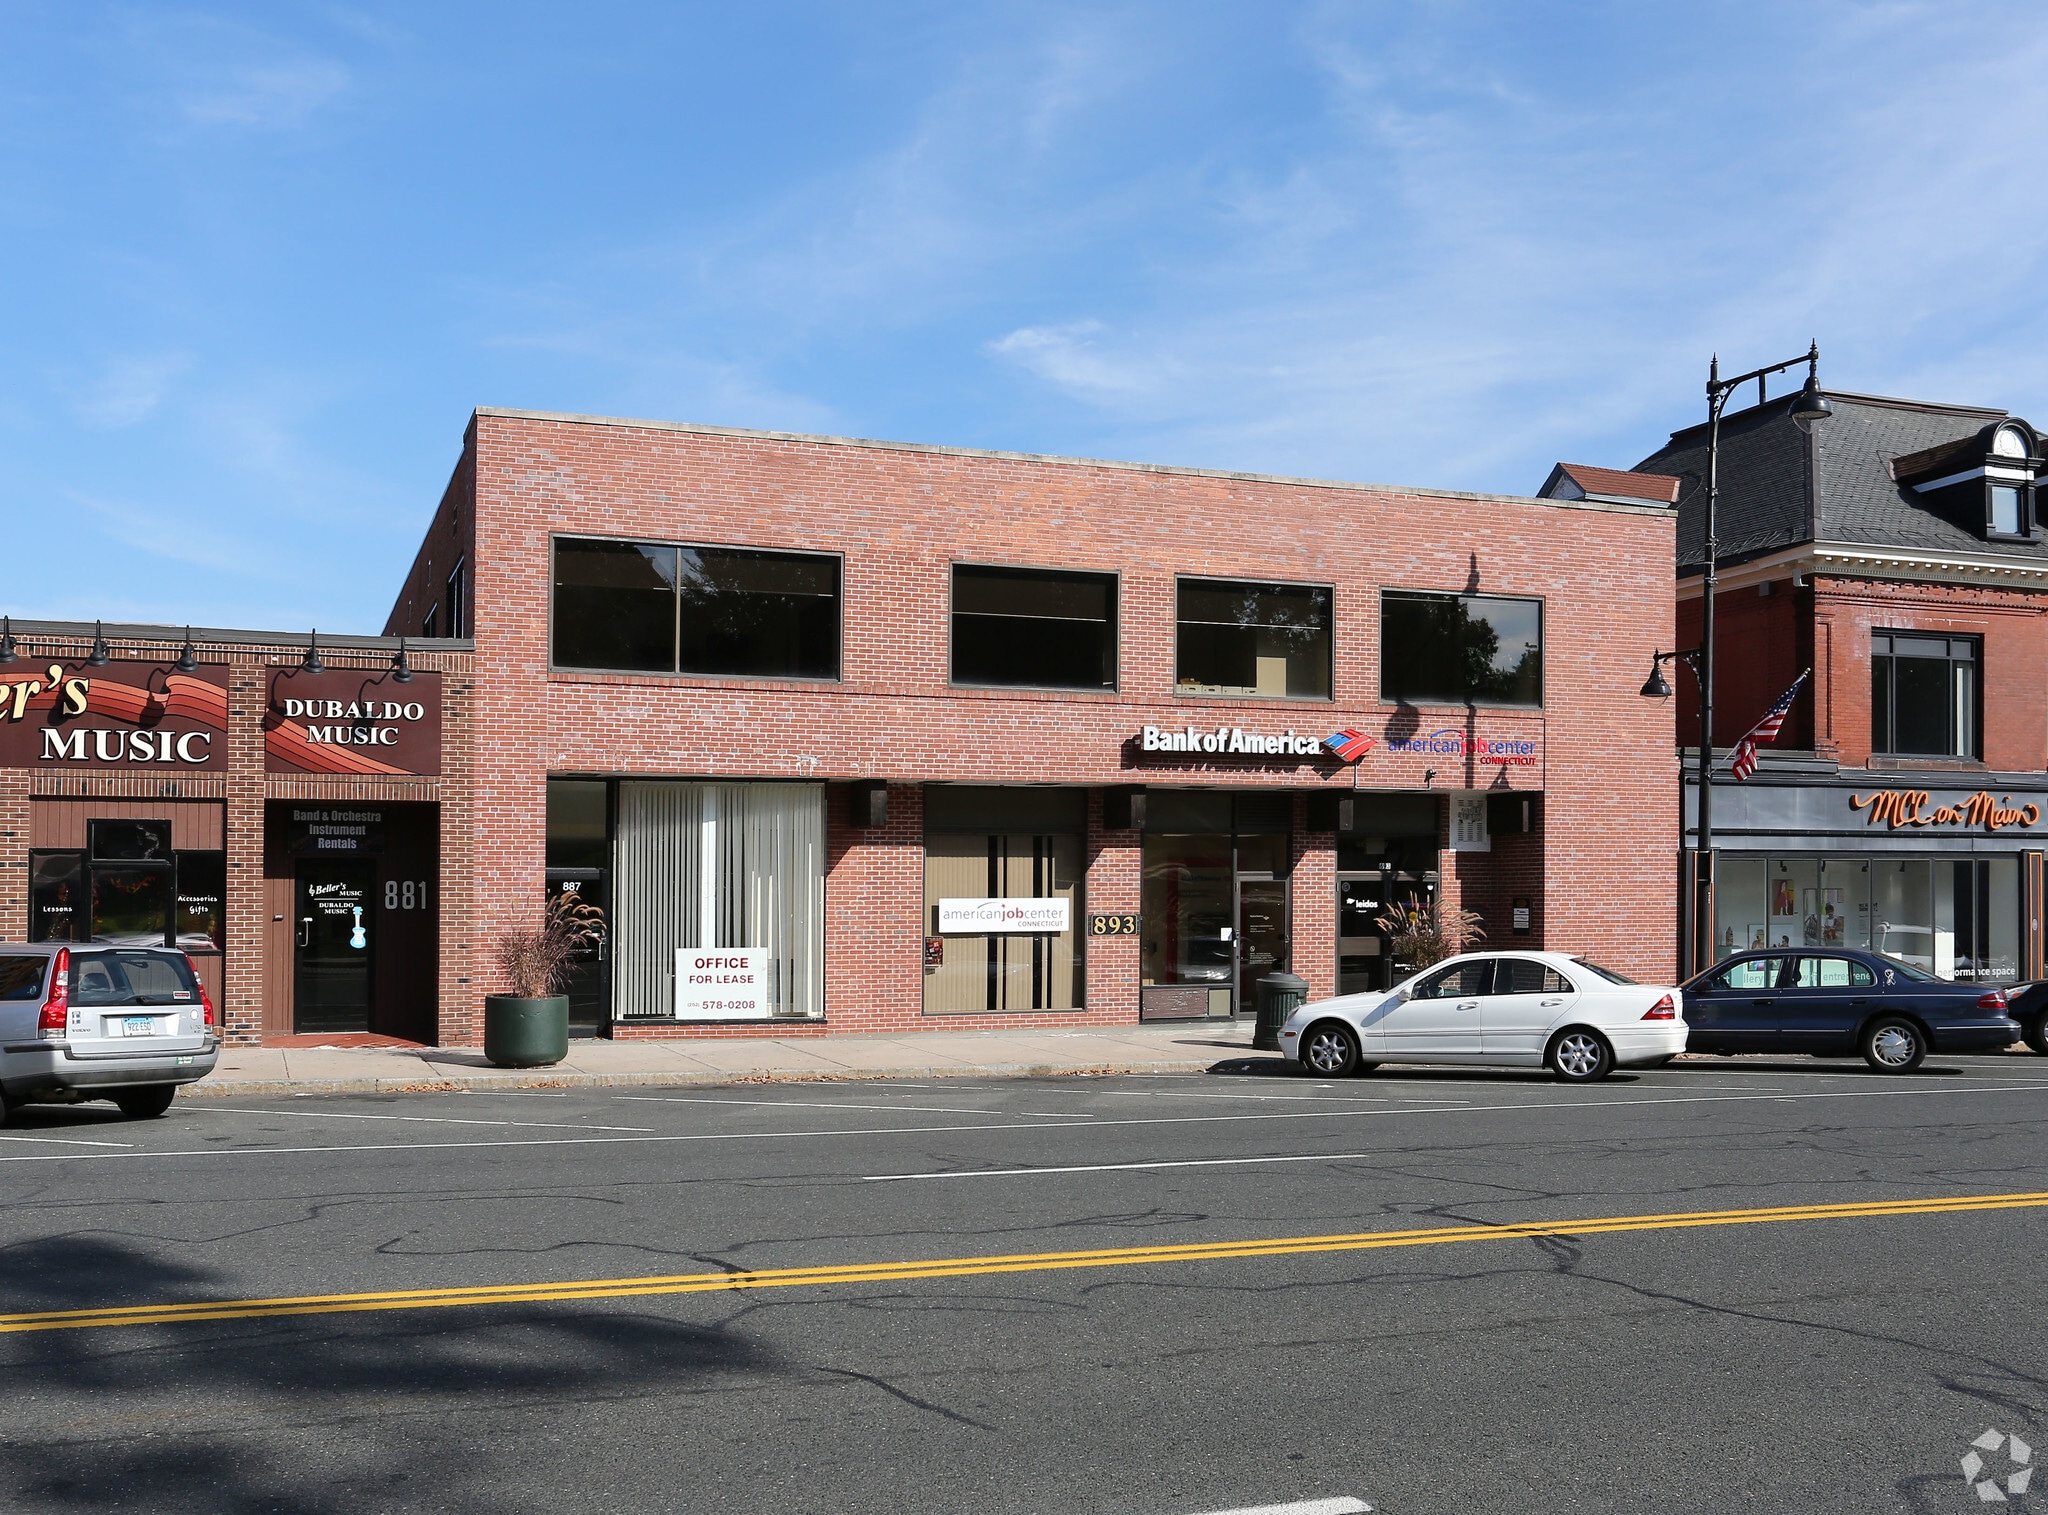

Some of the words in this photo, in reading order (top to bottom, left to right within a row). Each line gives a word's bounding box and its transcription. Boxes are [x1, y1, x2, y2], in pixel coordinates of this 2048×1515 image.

[284, 698, 425, 721] DUBALDO
[306, 725, 399, 745] MUSIC
[1143, 725, 1203, 752] Bank
[1203, 728, 1229, 753] of
[1228, 728, 1320, 756] America
[39, 728, 211, 763] MUSIC
[1480, 756, 1537, 766] CONNECTICUT
[1937, 806, 1965, 823] on
[1957, 790, 2040, 829] Main
[293, 810, 320, 821] Band
[321, 811, 329, 821] &
[331, 811, 381, 822] Orchestra
[309, 824, 366, 835] Instrument
[318, 838, 357, 849] Rentals
[315, 882, 347, 895] Beller's
[562, 881, 582, 891] 887
[177, 895, 218, 903] Accessories
[384, 880, 427, 910] 881
[42, 905, 73, 913] Lessons
[1355, 899, 1378, 908] leidos
[189, 905, 209, 915] Gifts
[943, 903, 1063, 922] americanjobcenter
[1017, 920, 1064, 928] CONNECTICUT
[1093, 916, 1135, 935] 893
[694, 957, 749, 969] OFFICE
[1991, 967, 2016, 978] space
[689, 975, 713, 984] FOR
[716, 975, 755, 984] LEASE
[702, 1000, 755, 1010] 578-0208
